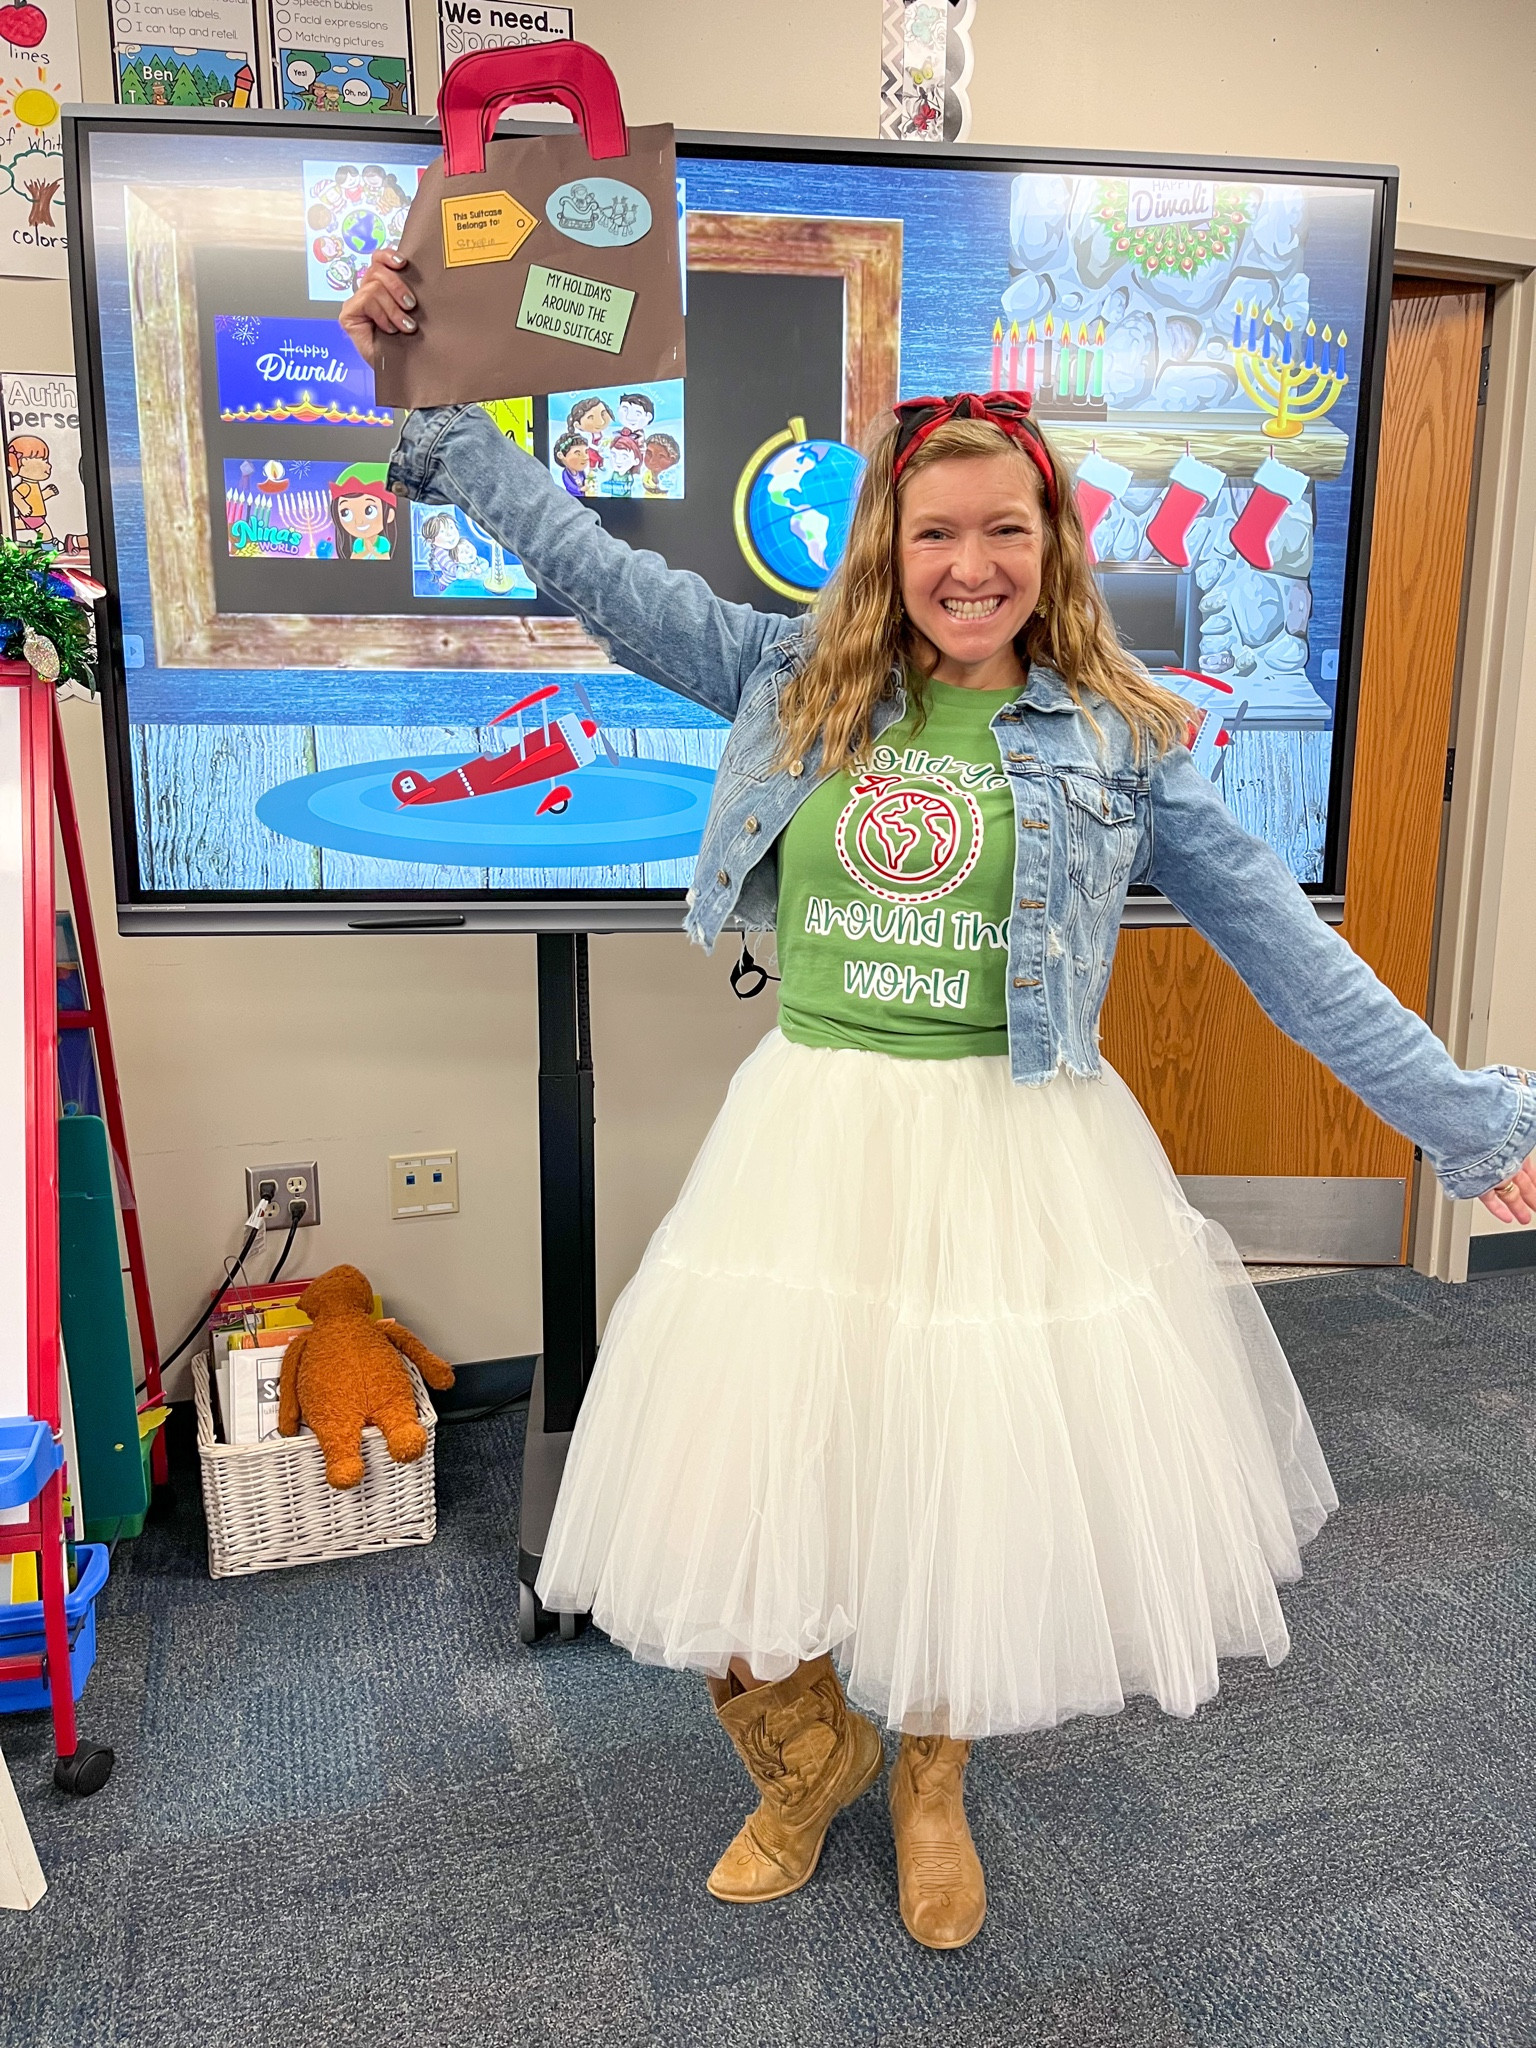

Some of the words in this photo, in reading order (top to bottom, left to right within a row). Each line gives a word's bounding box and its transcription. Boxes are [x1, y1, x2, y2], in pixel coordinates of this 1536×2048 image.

[134, 2, 141, 14] I
[144, 6, 163, 15] can
[166, 8, 186, 16] use
[189, 6, 222, 20] labels.
[334, 0, 373, 11] bubbles
[294, 13, 322, 25] Facial
[324, 19, 389, 31] expressions
[445, 1, 481, 24] We
[490, 11, 564, 34] need...
[136, 21, 142, 32] I
[145, 25, 165, 34] can
[169, 24, 186, 37] tap
[189, 27, 208, 38] and
[211, 29, 239, 40] retell.
[295, 31, 341, 46] Matching
[343, 34, 385, 48] pictures
[446, 24, 544, 54] Spaci
[9, 43, 50, 65] lines
[142, 66, 173, 82] Ben
[293, 69, 308, 77] Yes!
[1131, 182, 1209, 223] Diwali
[453, 212, 468, 221] This
[469, 208, 503, 219] Suitcase
[456, 219, 488, 231] Belongs
[13, 222, 69, 249] colors
[546, 272, 562, 289] MY
[562, 277, 612, 303] HOLIDAYS
[541, 294, 585, 317] AROUND
[587, 305, 607, 323] THE
[526, 310, 561, 332] WORLD
[563, 321, 614, 346] SUITCASE
[279, 338, 329, 359] Happy
[255, 352, 349, 383] Diwali
[259, 541, 299, 556] WORLD
